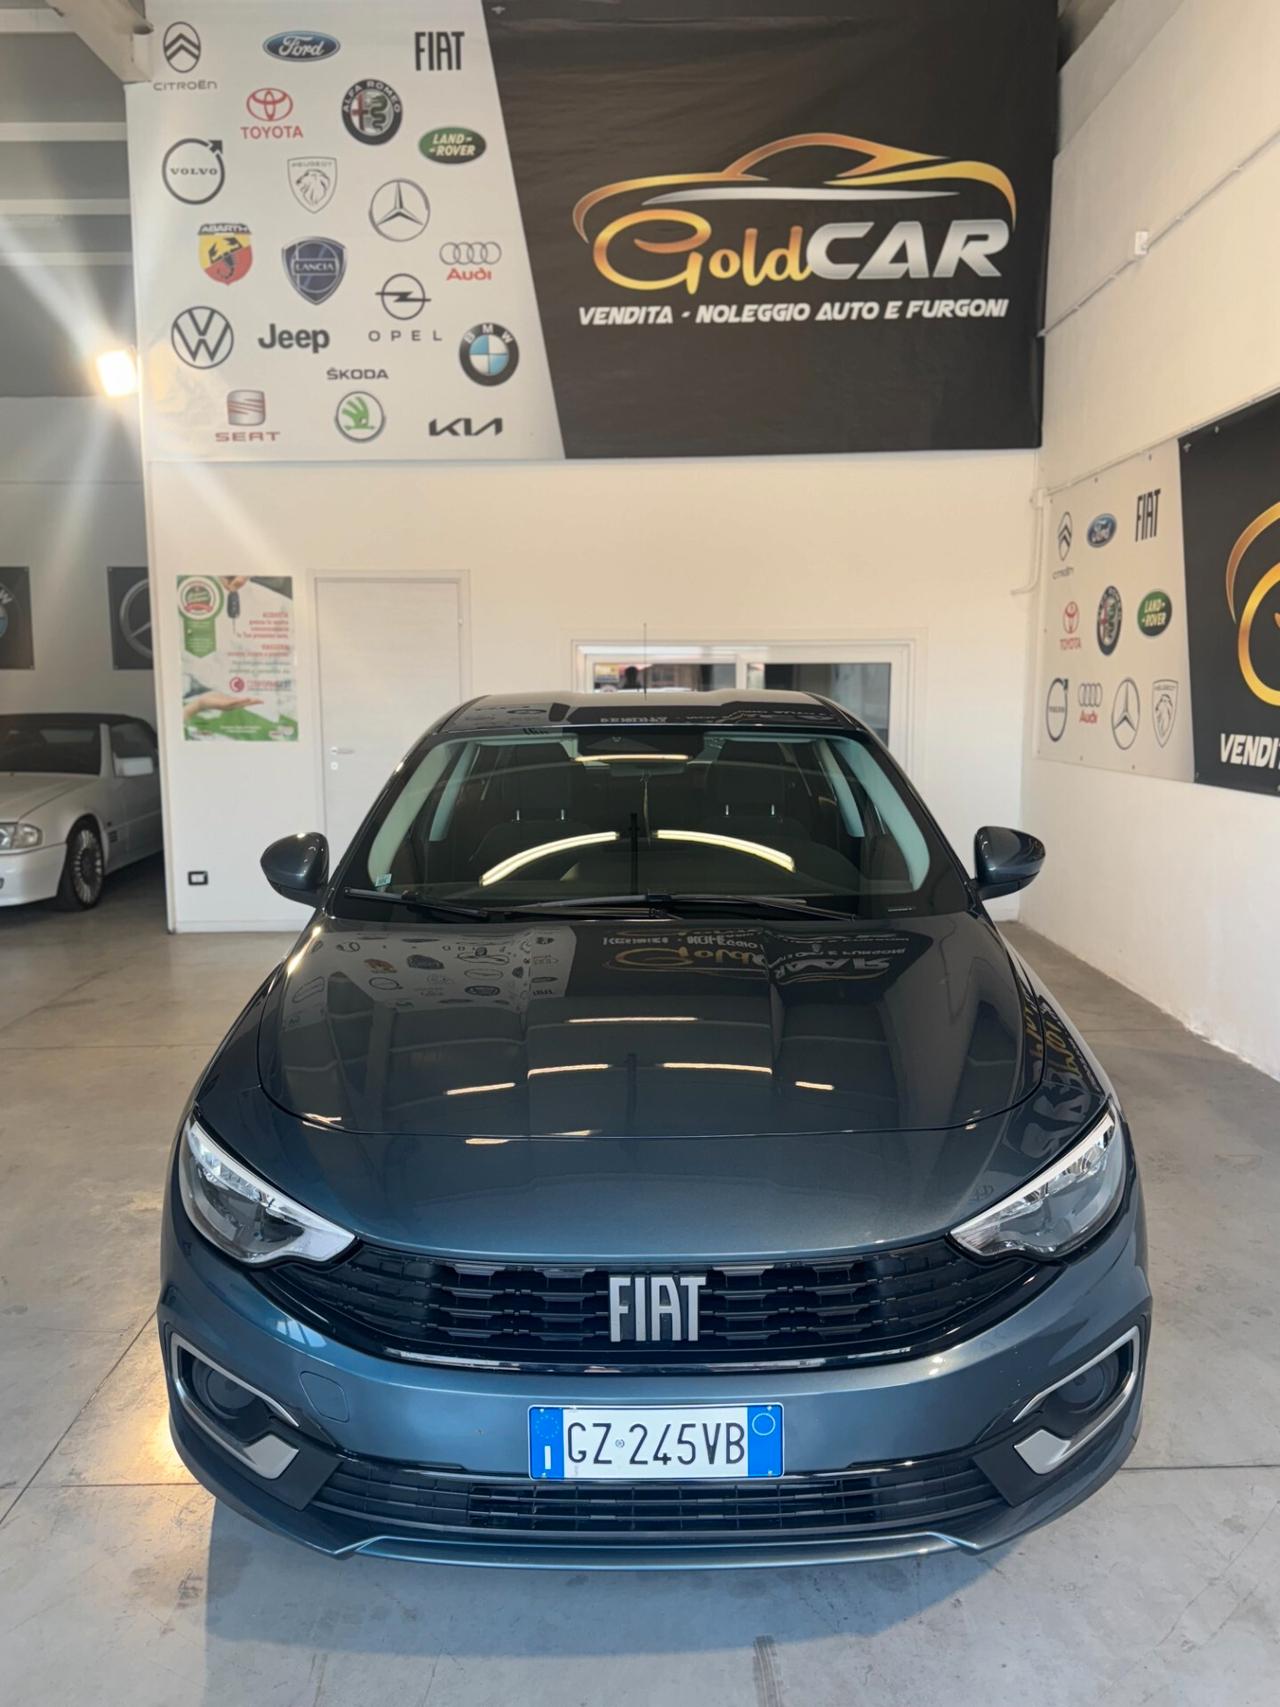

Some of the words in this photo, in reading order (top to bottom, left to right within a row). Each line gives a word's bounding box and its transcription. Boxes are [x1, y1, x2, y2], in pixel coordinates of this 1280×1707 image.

[278, 35, 326, 58] Ford
[414, 31, 466, 71] FIAT
[342, 84, 363, 113] ALFA
[366, 80, 401, 113] ROMEO
[240, 125, 304, 140] TOYOTA
[170, 166, 218, 176] VOLVO
[200, 223, 251, 234] ABARTH
[446, 267, 493, 281] Audi
[578, 306, 674, 326] VENDITA
[695, 303, 810, 324] NOLEGGIO
[815, 301, 880, 321] AUTO
[884, 300, 903, 318] E
[906, 299, 1010, 318] FURGONI
[257, 323, 330, 354] Jeep
[367, 329, 443, 343] OPEL
[464, 322, 514, 345] BMW
[326, 366, 389, 381] ŠKODA
[215, 432, 281, 442] SEAT
[1135, 489, 1161, 542] FIAT
[1220, 733, 1280, 770] VENDI
[609, 1275, 707, 1343] FIAT
